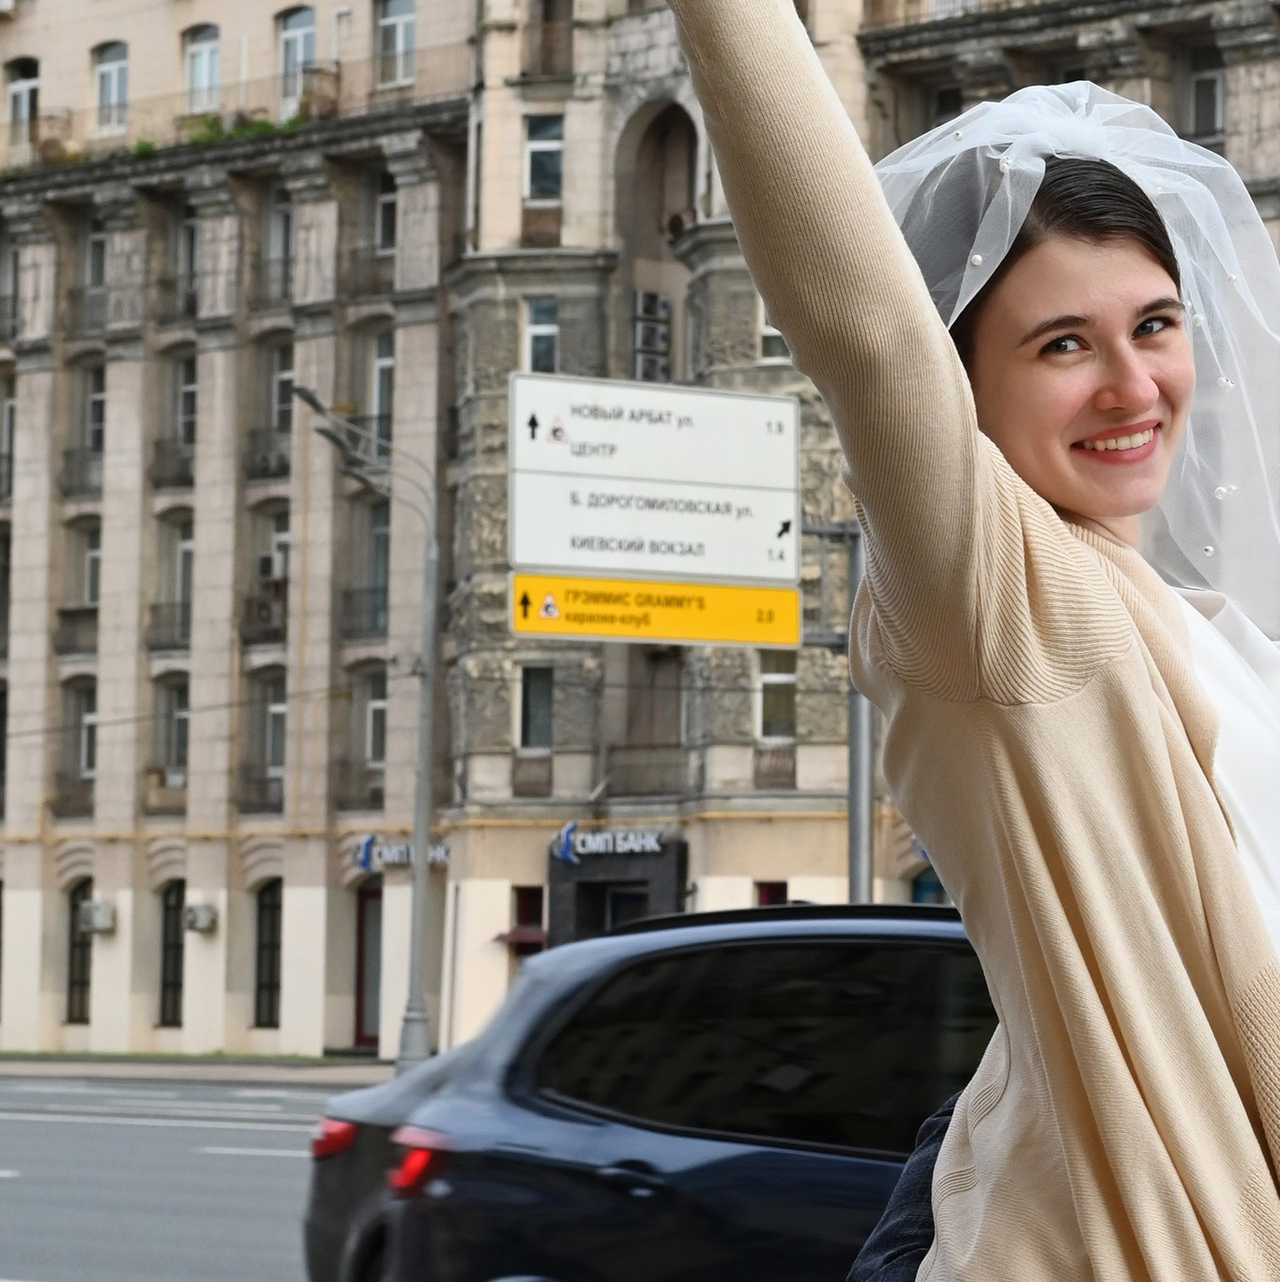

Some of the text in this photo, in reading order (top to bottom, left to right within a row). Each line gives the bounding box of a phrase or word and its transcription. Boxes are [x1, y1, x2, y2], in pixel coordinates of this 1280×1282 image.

[570, 404, 624, 421] НОВЫЙ
[628, 409, 672, 425] АРБАТ
[570, 442, 618, 457] ЦЕНТР
[587, 492, 732, 515] ДОРОГОМИЛОВСКАЯ
[570, 535, 706, 557] КИЕВСКИЙ ВОКЗАЛ
[615, 830, 661, 854] БАНК
